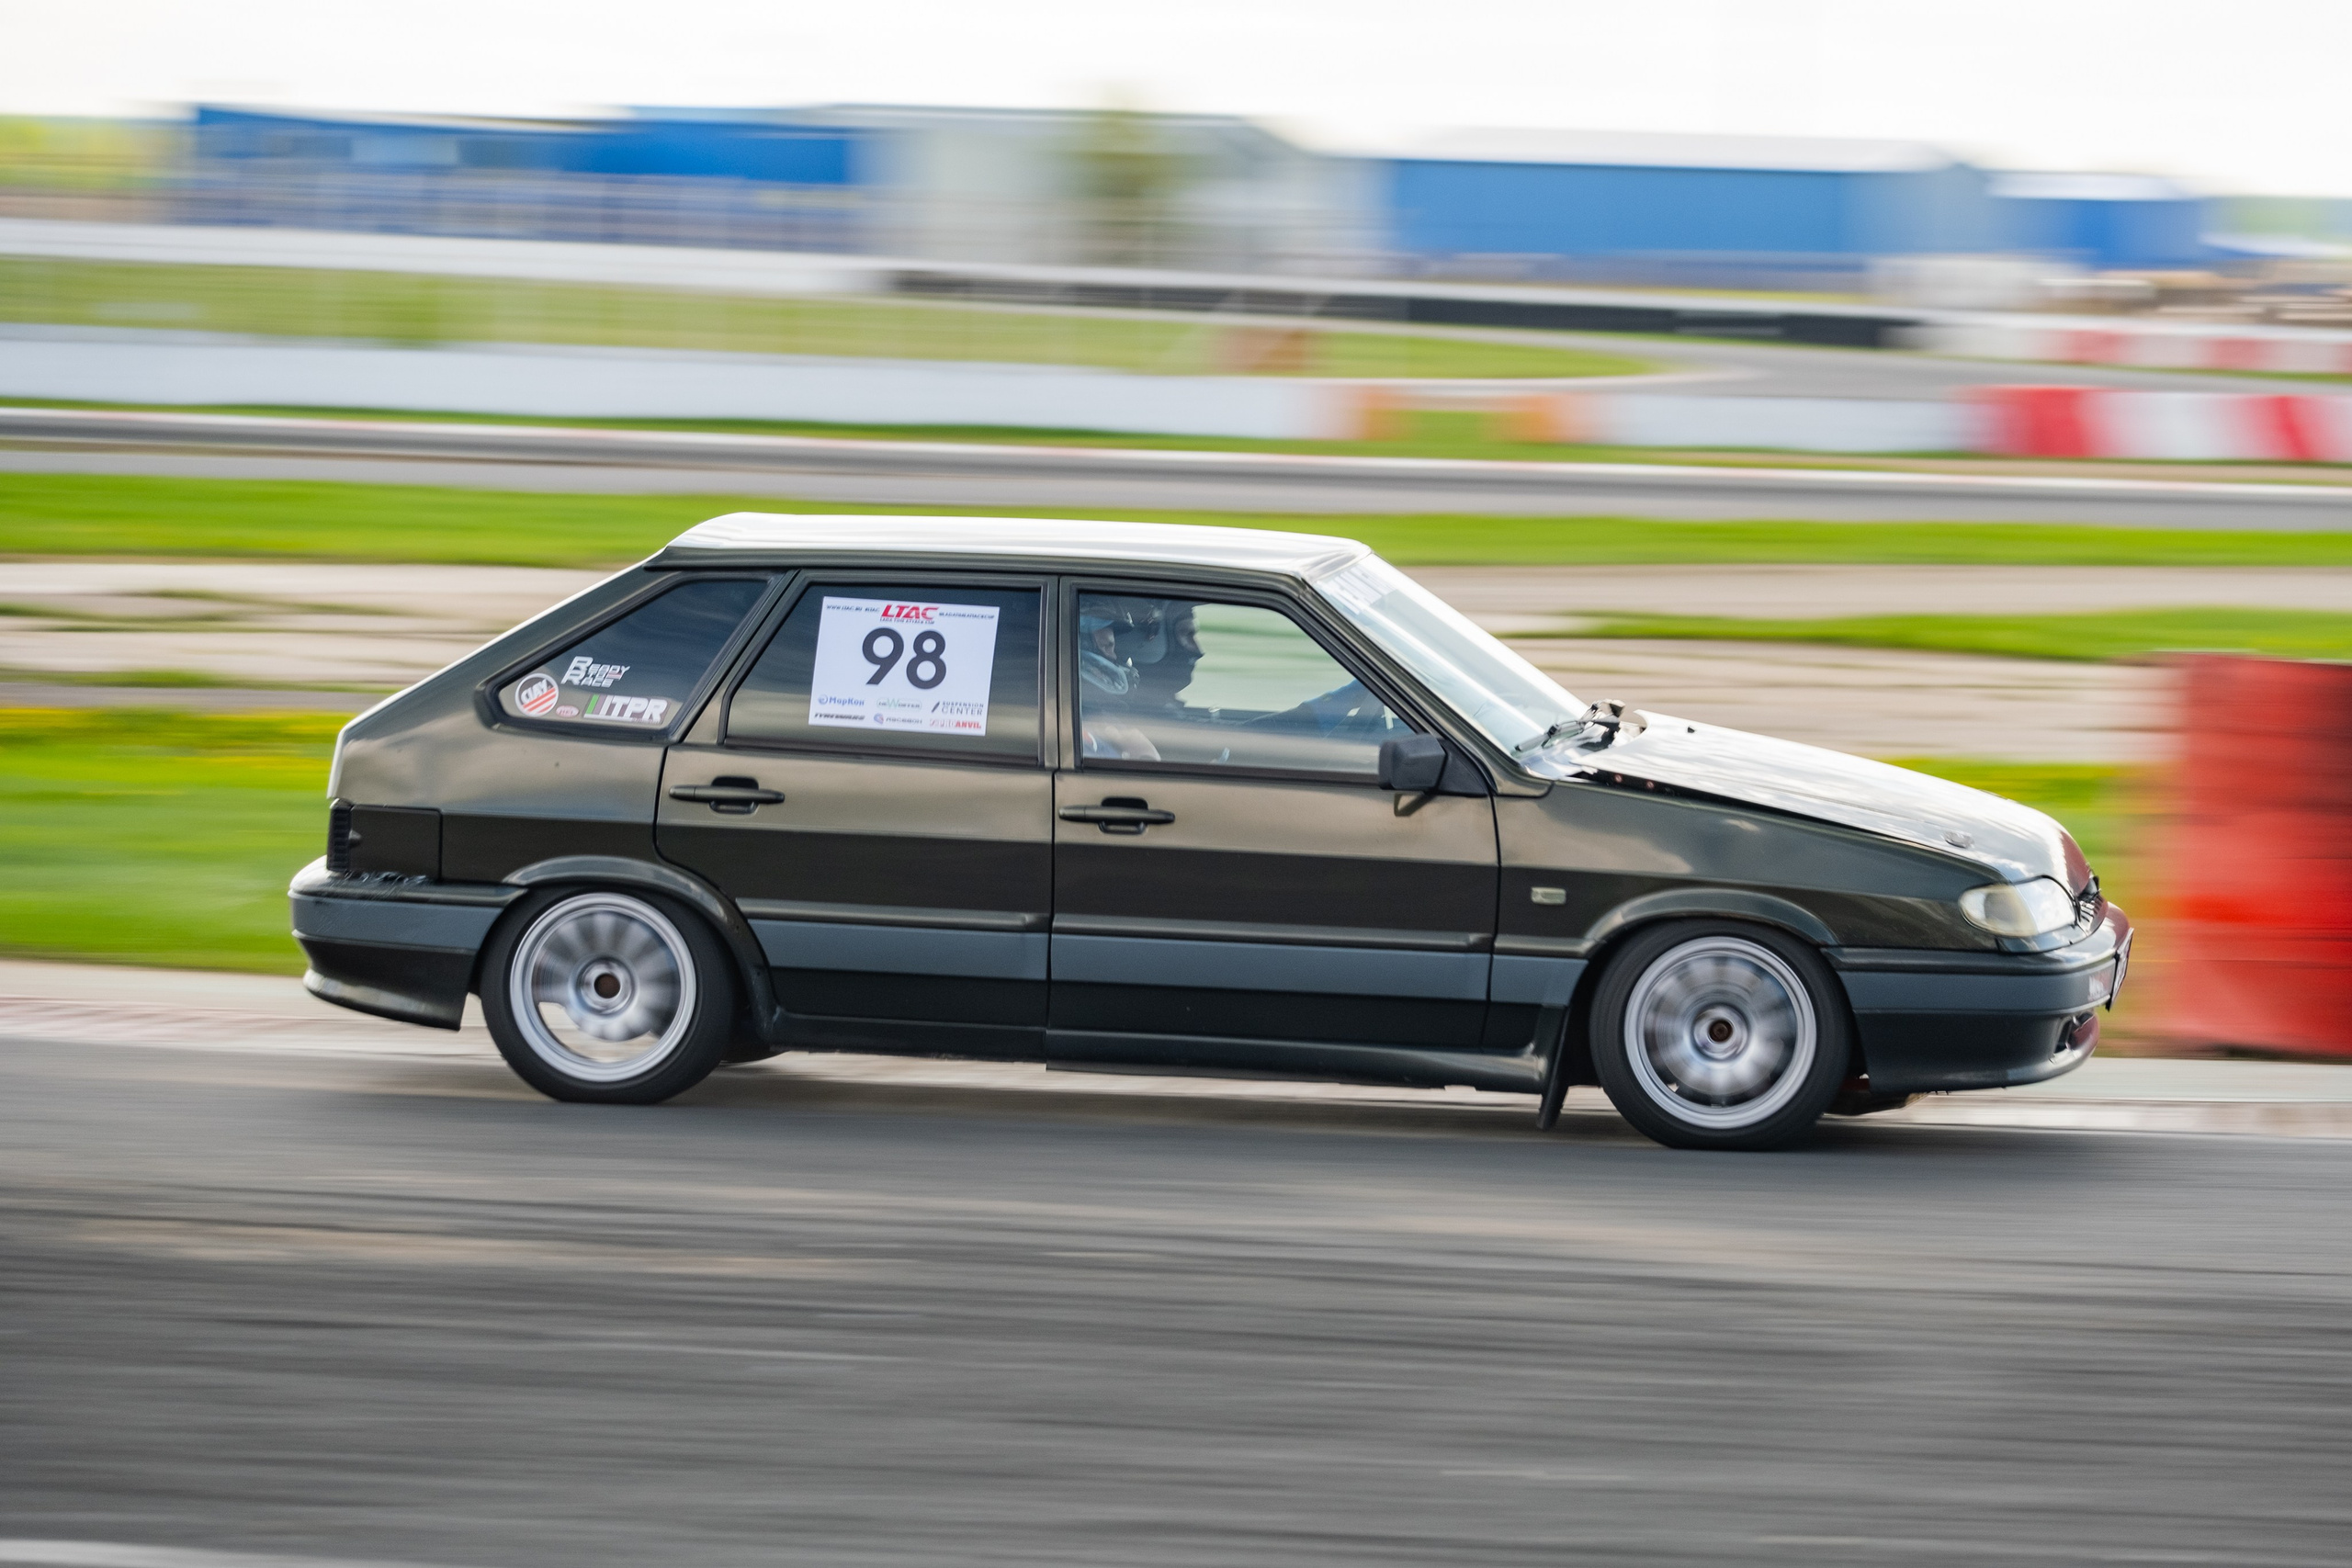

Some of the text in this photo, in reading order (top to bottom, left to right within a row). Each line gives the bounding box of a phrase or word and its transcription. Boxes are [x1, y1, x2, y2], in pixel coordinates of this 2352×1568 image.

[881, 604, 940, 620] LTAC
[862, 626, 947, 690] 98
[941, 705, 983, 716] CENTER
